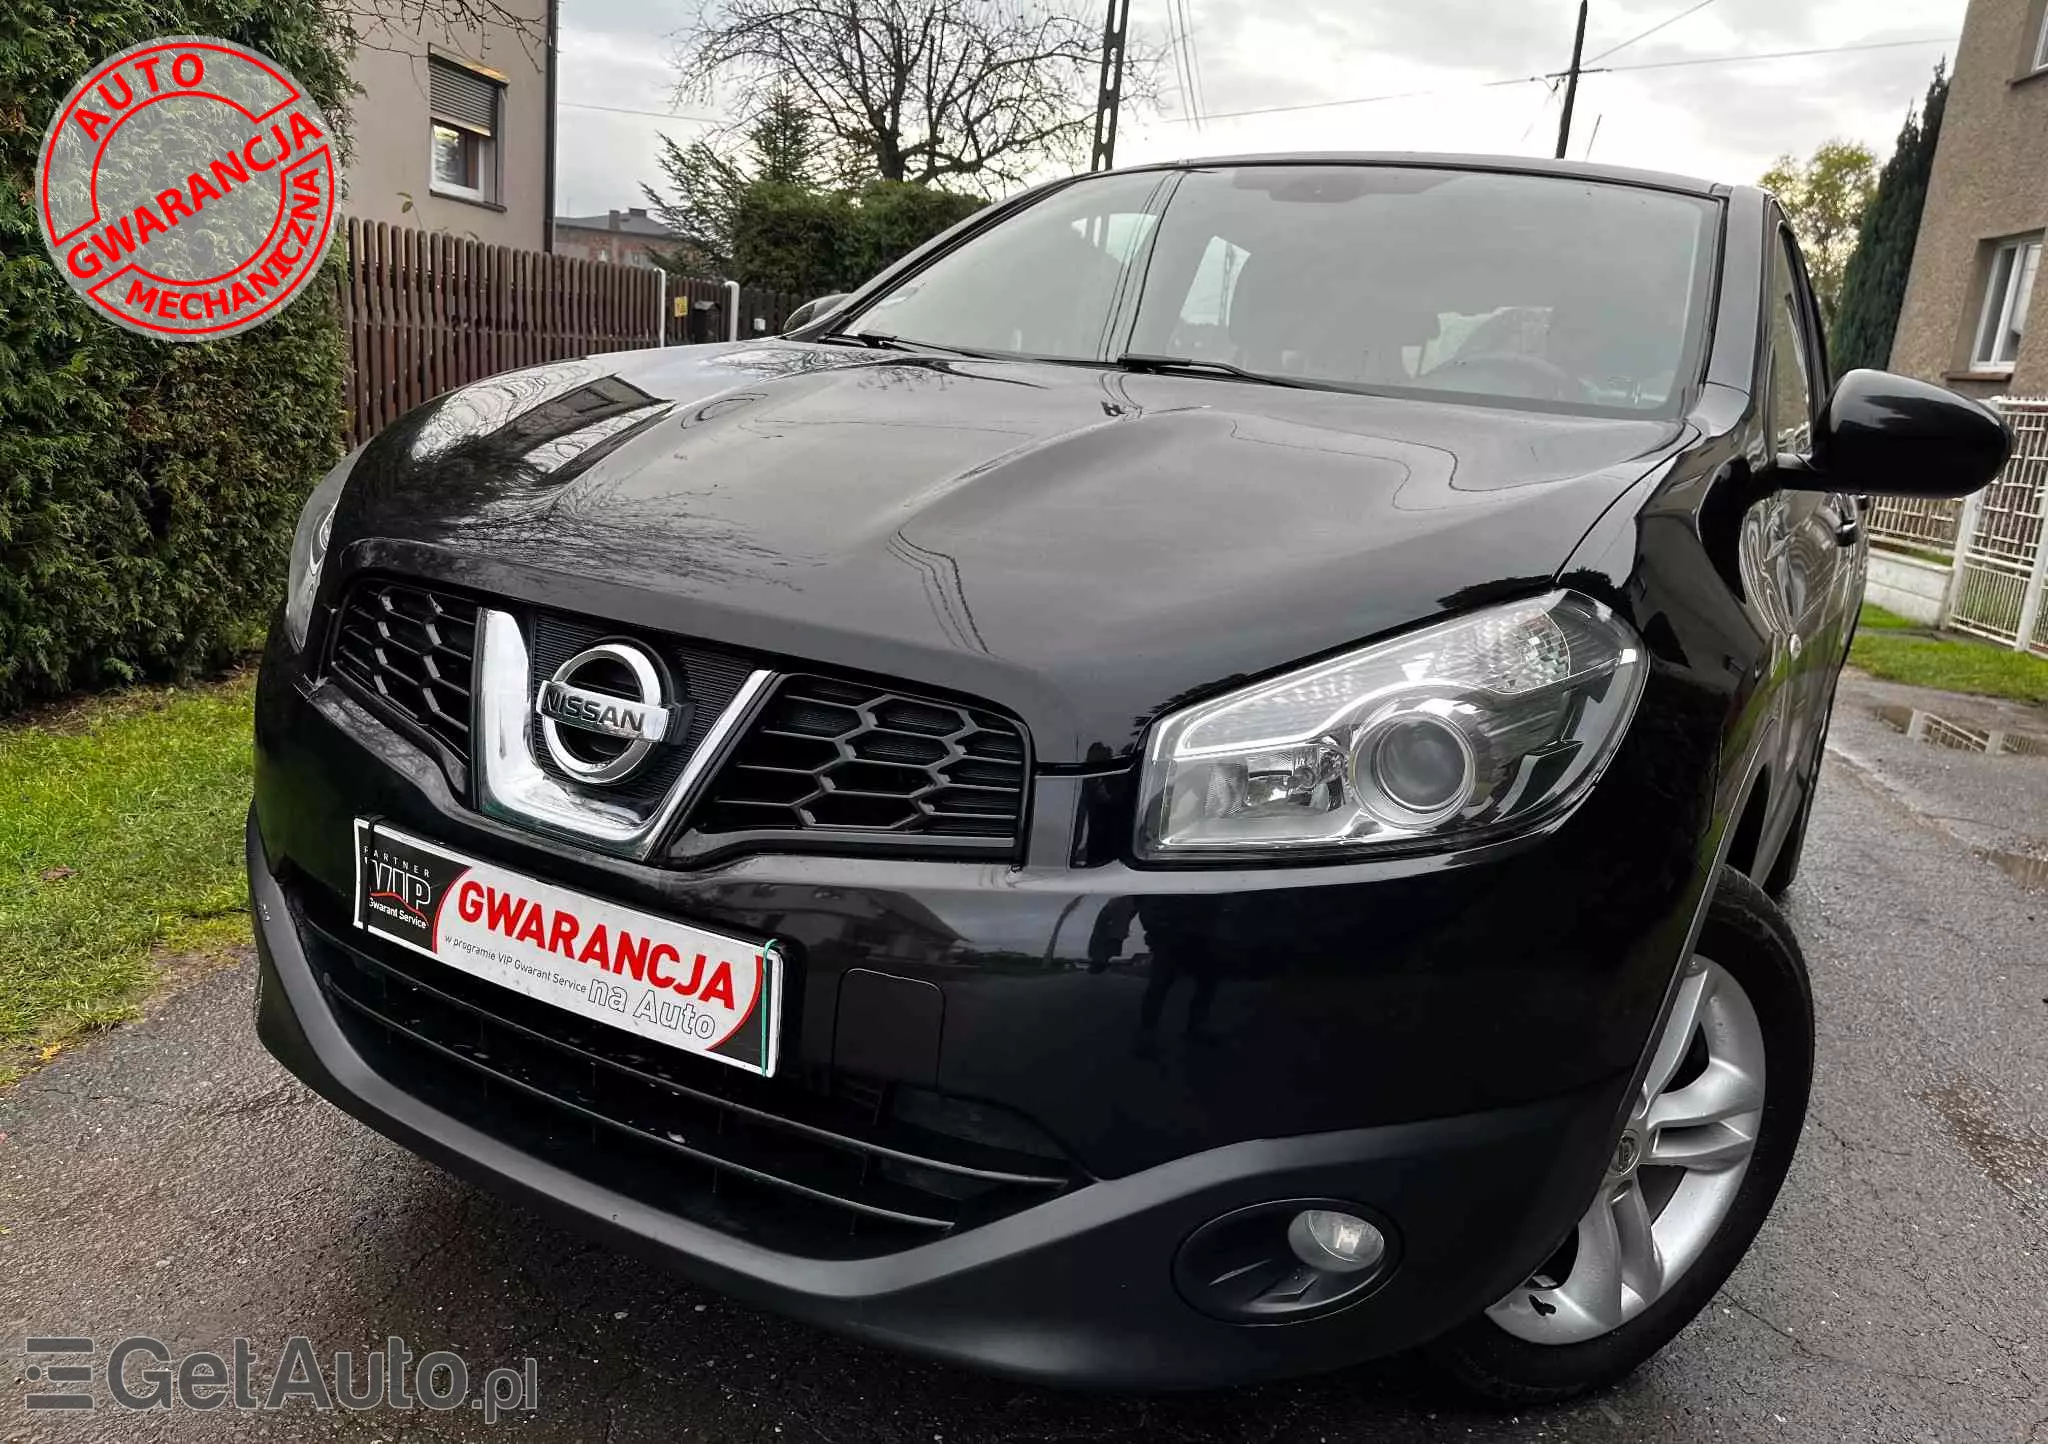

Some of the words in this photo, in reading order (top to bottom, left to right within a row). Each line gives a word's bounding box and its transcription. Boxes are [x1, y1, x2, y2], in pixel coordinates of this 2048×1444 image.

[542, 688, 645, 732] NISSAN
[364, 856, 431, 910] VIP
[399, 909, 427, 929] Service
[458, 880, 735, 1011] GWARANCJA
[444, 934, 453, 943] w
[453, 938, 496, 961] programie
[498, 951, 513, 965] VIP
[514, 959, 551, 981] Gwarant
[553, 973, 587, 993] Service
[587, 978, 629, 1013] na
[632, 989, 717, 1040] Auto
